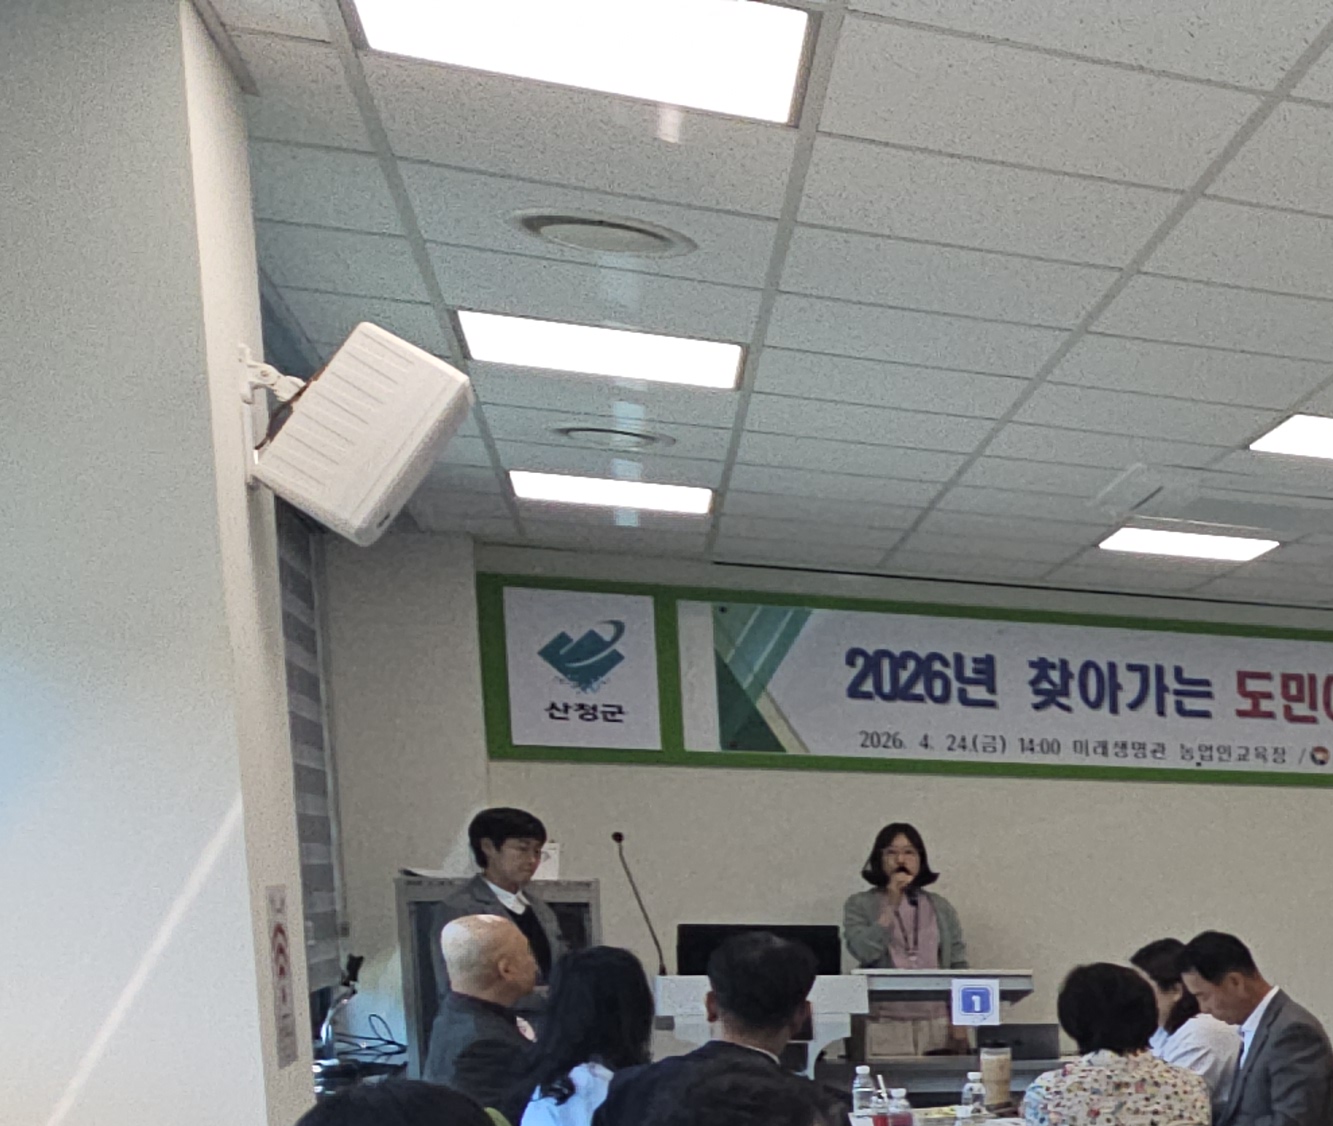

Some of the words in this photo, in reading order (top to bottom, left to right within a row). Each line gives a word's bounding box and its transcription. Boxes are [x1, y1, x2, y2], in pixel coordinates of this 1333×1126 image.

[845, 648, 999, 709] 2026년
[1027, 656, 1214, 719] 찾아가는
[545, 702, 627, 723] 산청군
[859, 730, 906, 749] 2026.
[1019, 737, 1061, 755] 14:00
[1073, 739, 1166, 760] 미래생명관
[972, 995, 981, 1012] 1
